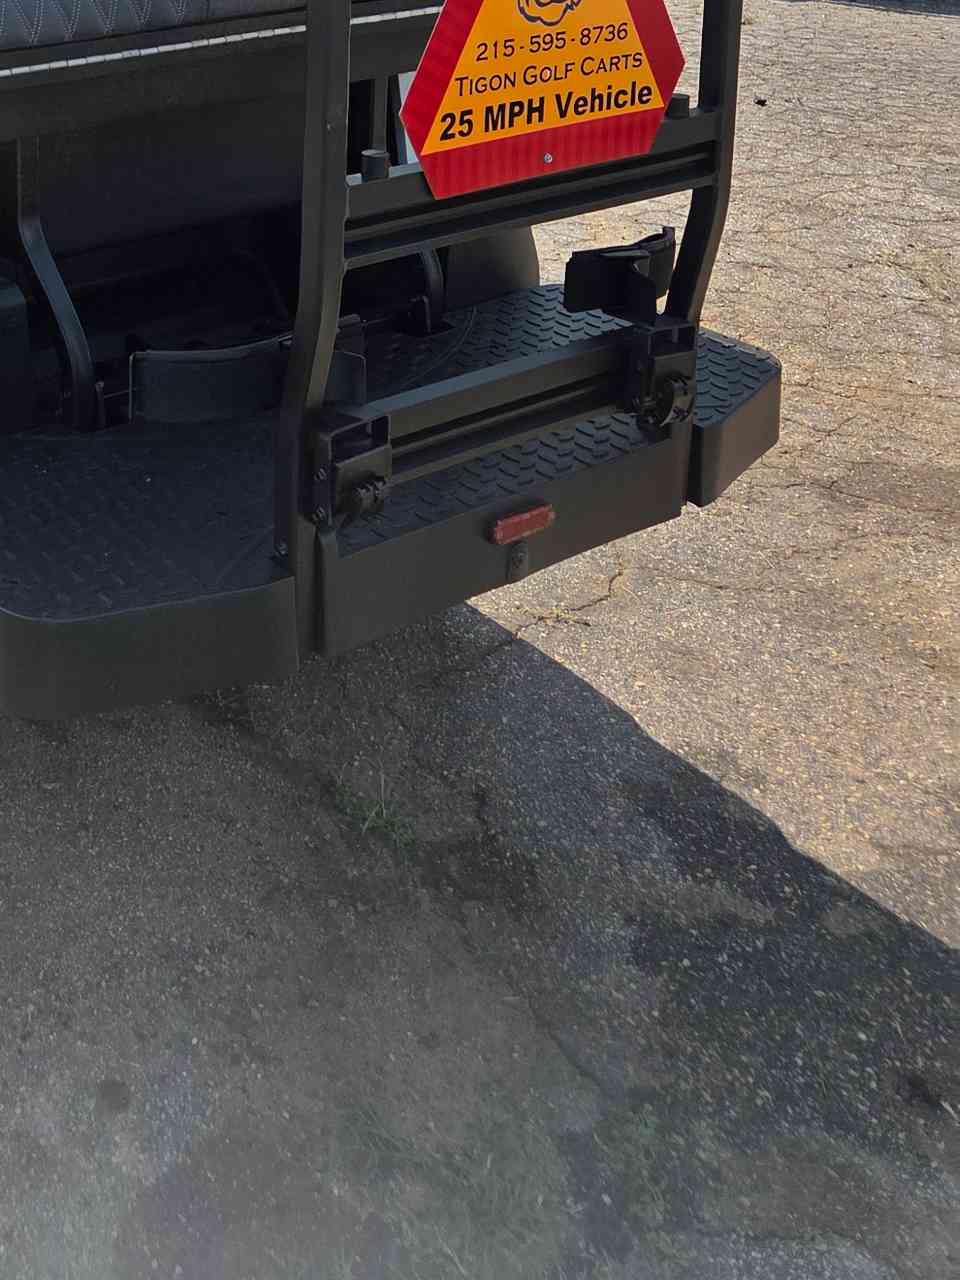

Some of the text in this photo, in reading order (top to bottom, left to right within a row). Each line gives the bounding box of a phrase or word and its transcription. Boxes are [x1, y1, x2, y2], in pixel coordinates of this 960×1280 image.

[454, 52, 644, 97] TIGON GOLF CARTS
[440, 80, 654, 142] 25 MPH Vehicle
